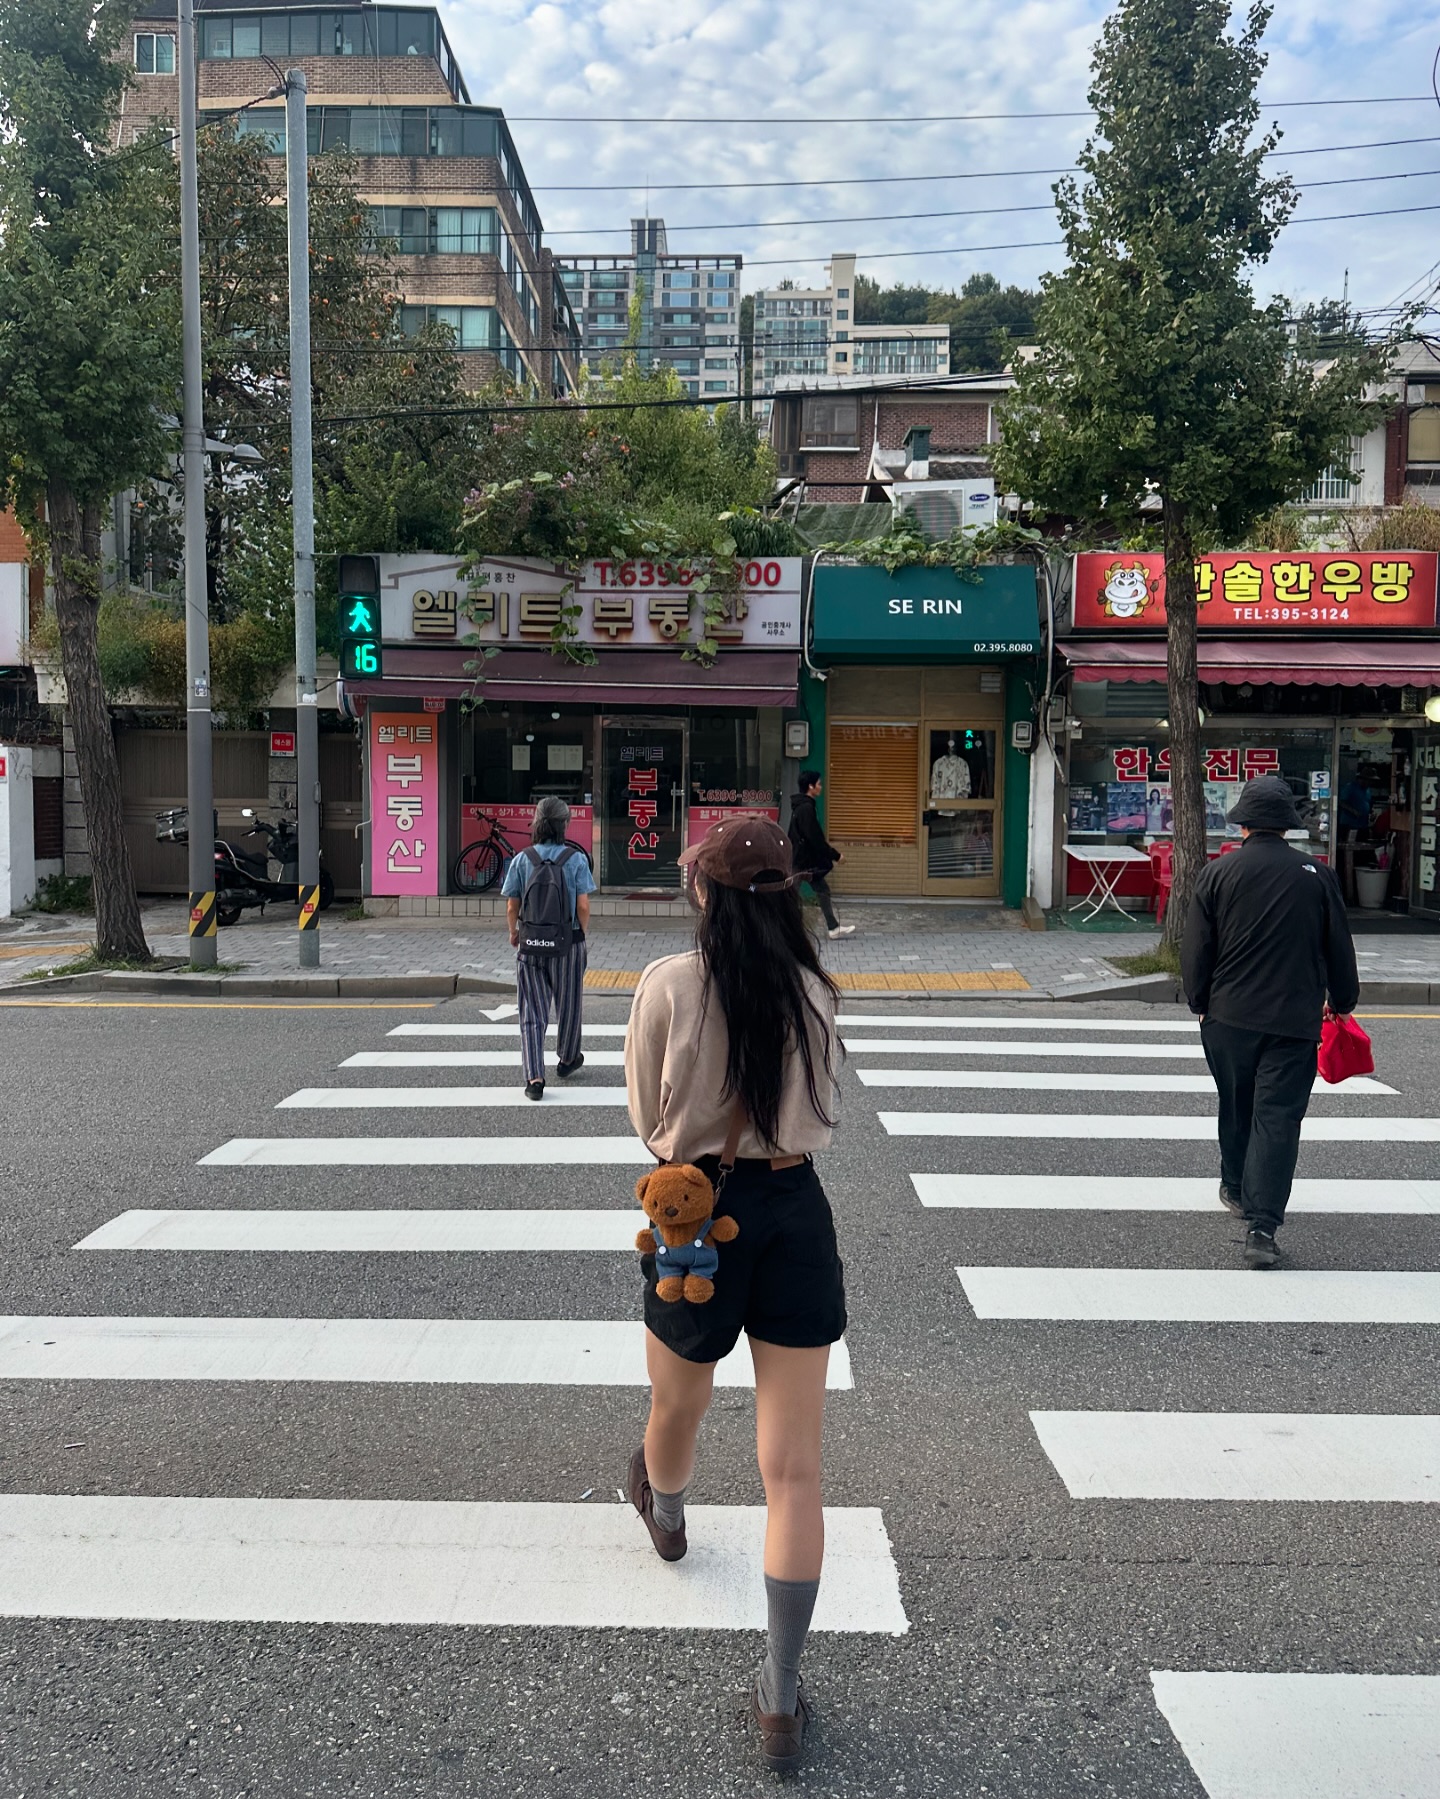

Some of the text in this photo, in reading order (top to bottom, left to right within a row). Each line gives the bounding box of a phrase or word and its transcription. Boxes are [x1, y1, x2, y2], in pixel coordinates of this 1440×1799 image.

[412, 590, 748, 639] 엘리트 부동산
[888, 599, 962, 614] SE RIN
[1233, 608, 1350, 620] TEL:395-3124
[973, 643, 1033, 653] 02.395.8080
[355, 643, 378, 673] 16
[377, 725, 432, 744] 엘리트
[620, 746, 664, 762] 엘리트
[1203, 748, 1280, 782] 전문
[385, 753, 427, 874] 부동산
[628, 767, 660, 860] 부동산
[526, 939, 555, 947] adidas
